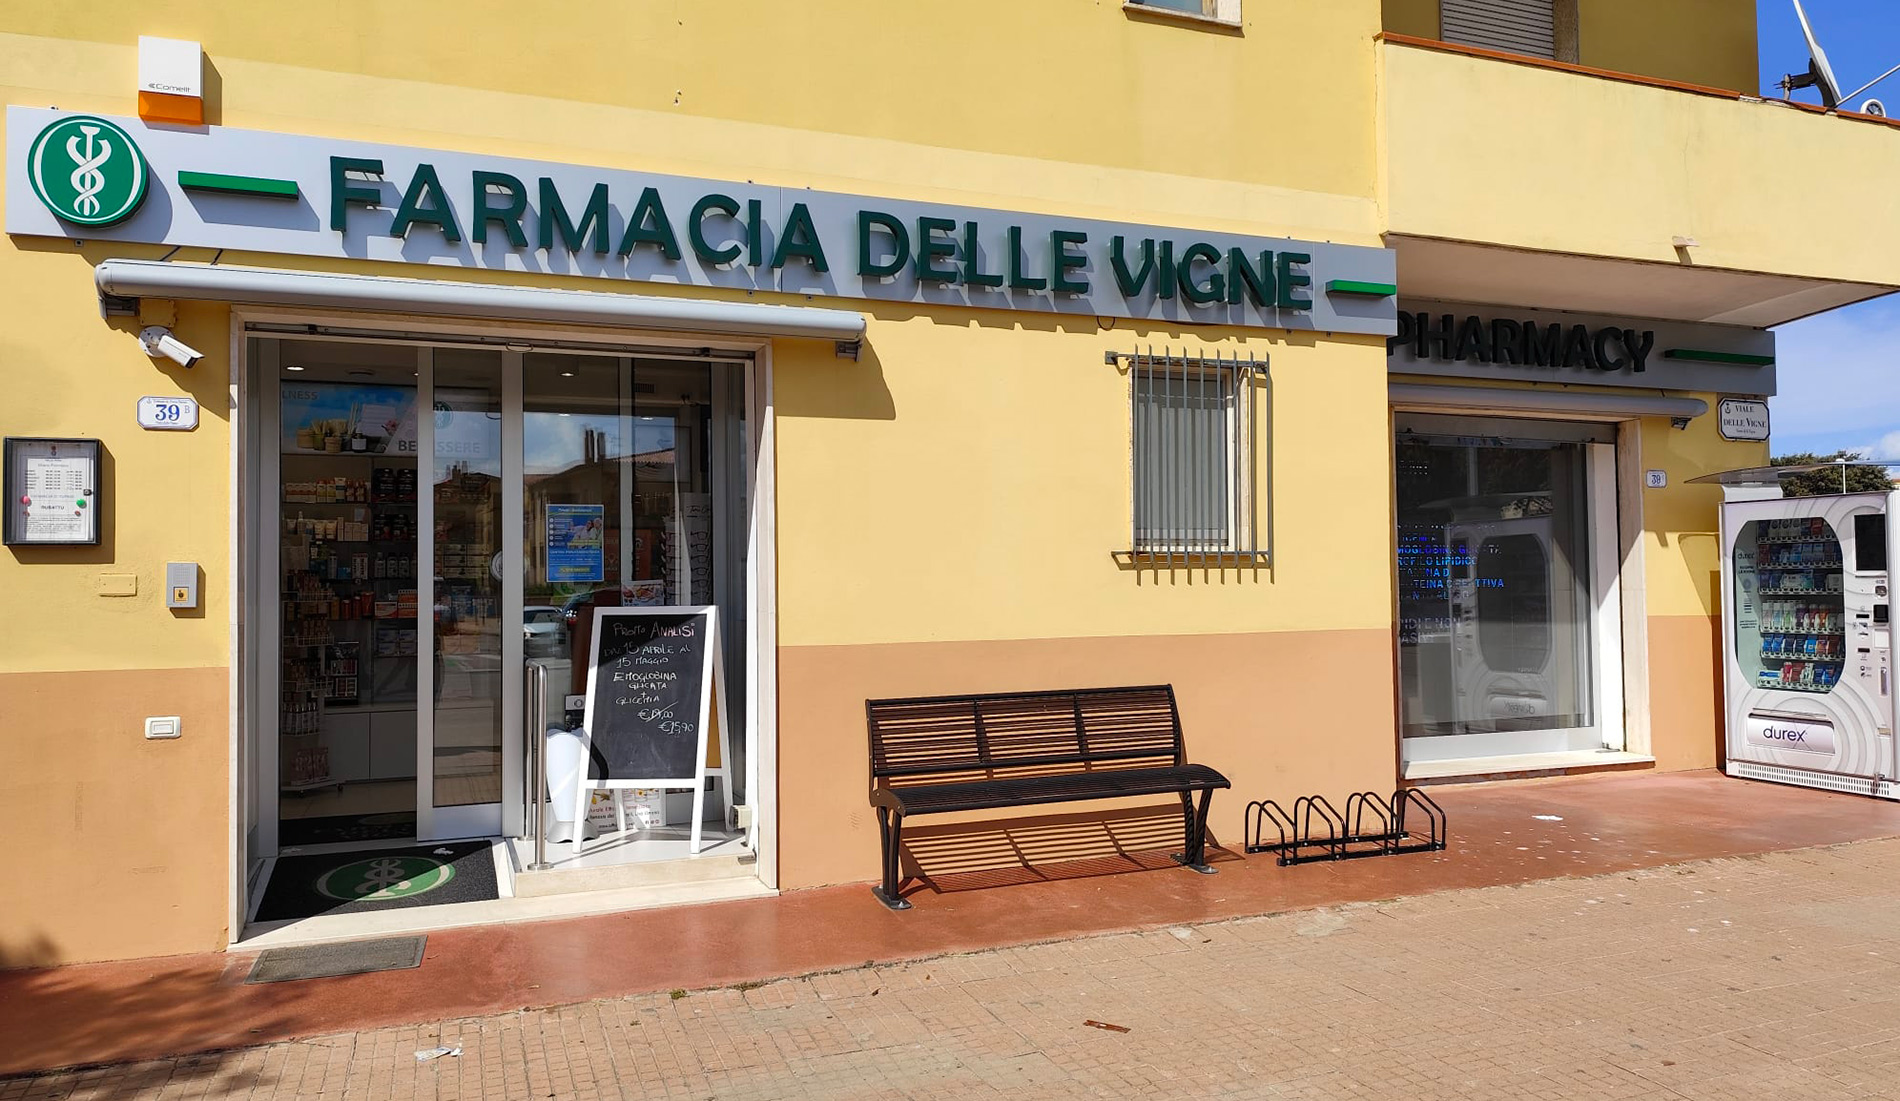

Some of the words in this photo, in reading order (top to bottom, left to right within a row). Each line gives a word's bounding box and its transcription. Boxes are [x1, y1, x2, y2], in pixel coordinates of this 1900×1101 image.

[330, 156, 829, 273] FARMACIA
[856, 210, 1090, 295] DELLE
[1110, 235, 1312, 311] VIGNE
[1387, 310, 1654, 373] PHARMACY
[155, 403, 181, 422] 39
[641, 643, 674, 655] APRILE
[616, 657, 632, 669] 15
[613, 671, 677, 683] EMOGLOBINA
[1763, 725, 1806, 742] durex
